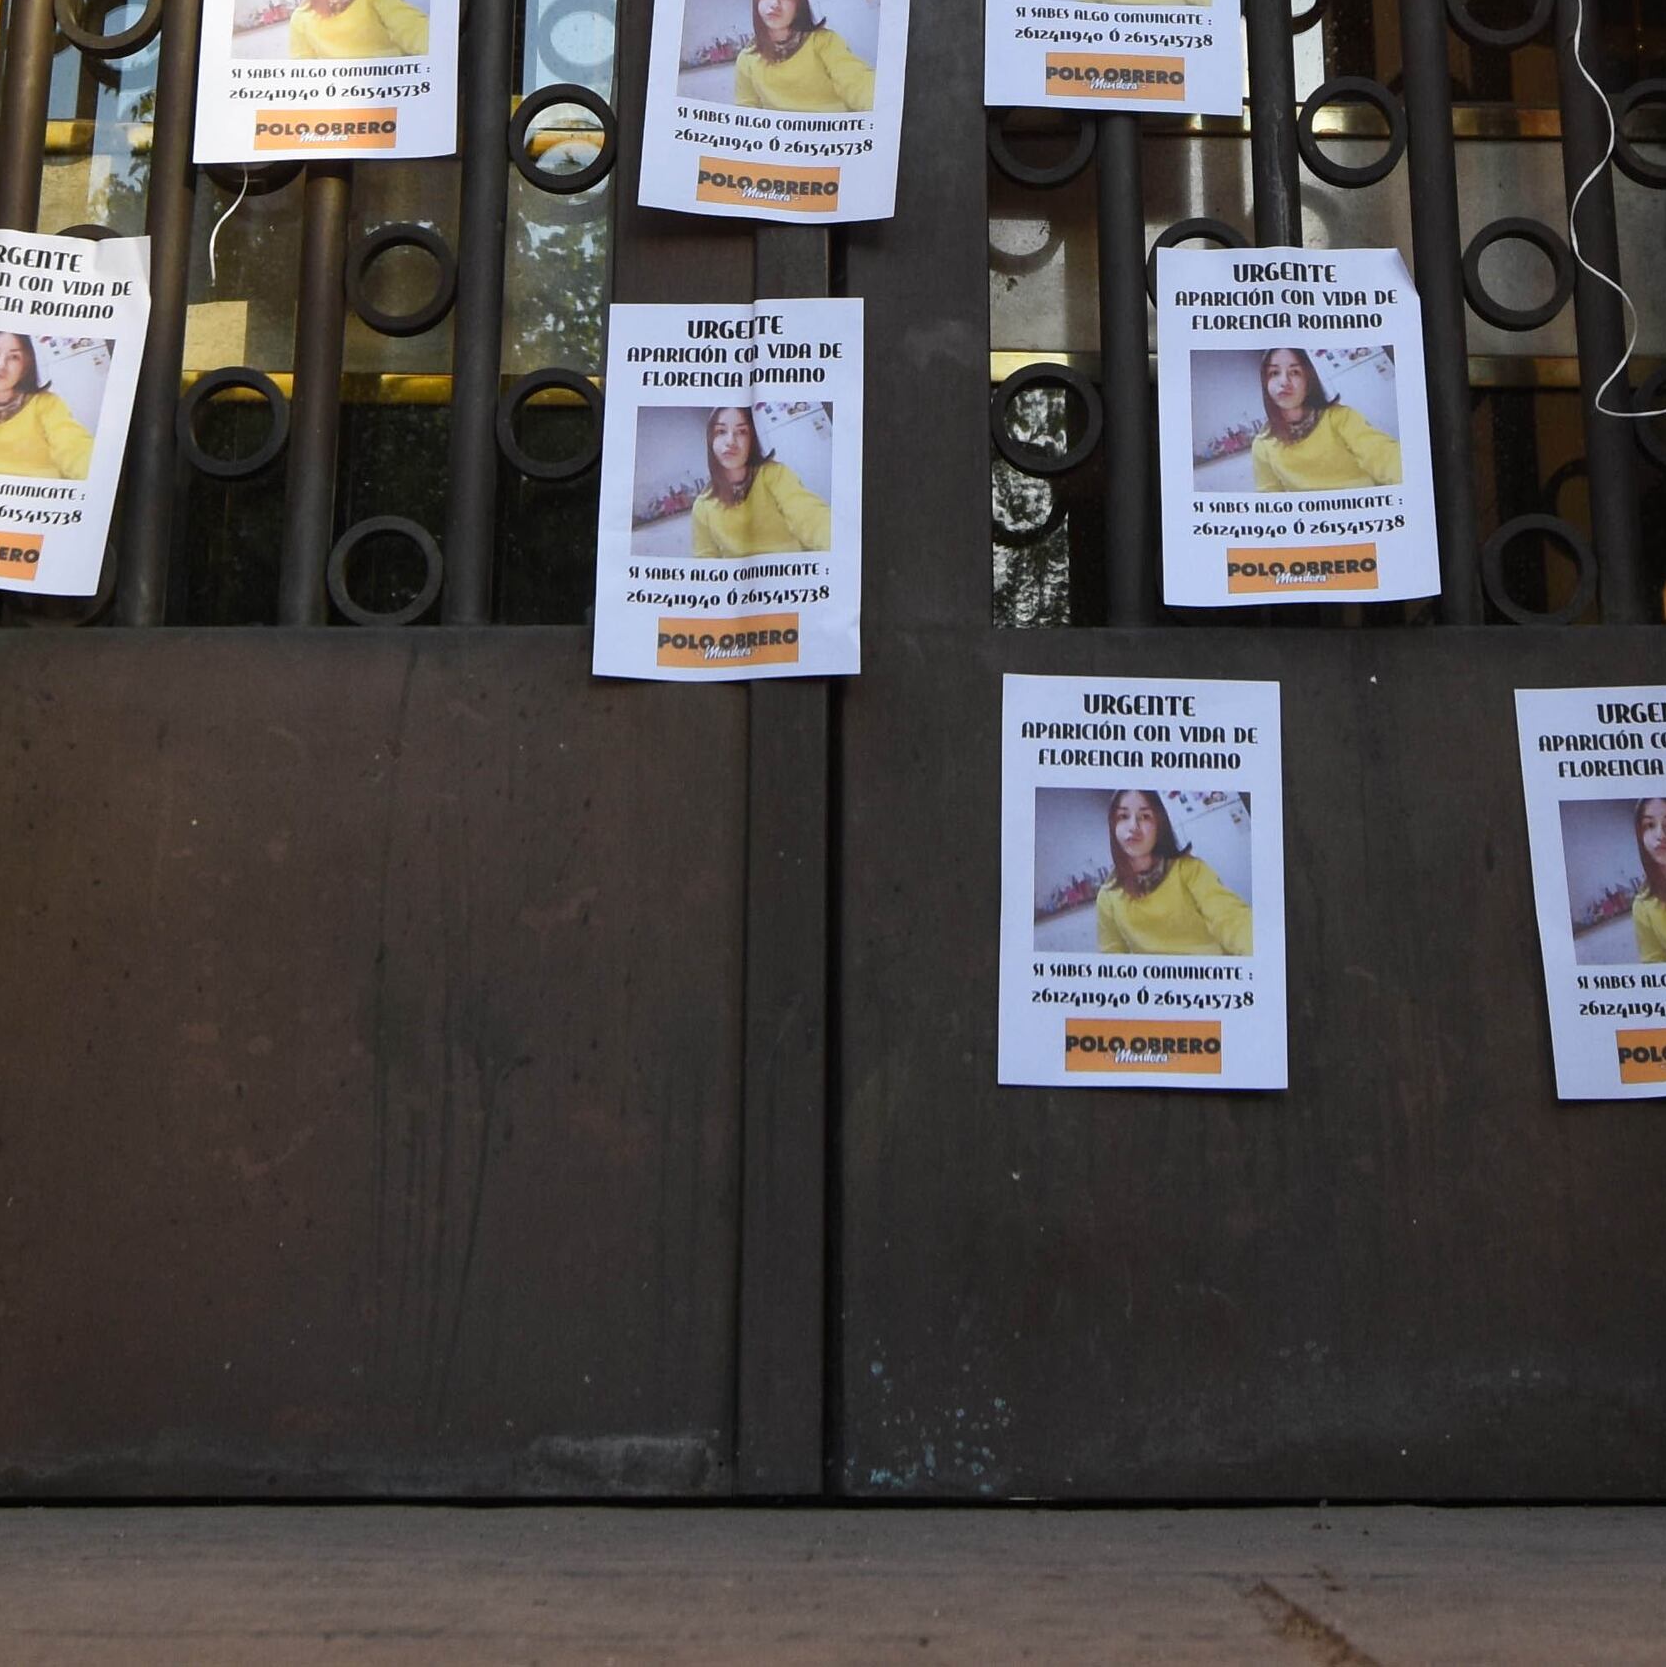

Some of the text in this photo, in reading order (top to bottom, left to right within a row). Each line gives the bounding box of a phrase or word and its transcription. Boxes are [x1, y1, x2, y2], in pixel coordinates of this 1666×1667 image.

[1233, 262, 1337, 282] URGENTE
[1176, 288, 1398, 306] APARICIÓN CON VIDA DE
[31, 300, 113, 319] ROMANO
[1192, 313, 1382, 330] FLORENCIA ROMANO
[642, 371, 742, 387] FLORENCIA
[1193, 502, 1203, 513] SI
[1210, 502, 1249, 513] SABES
[1255, 501, 1293, 513] ALGO
[1228, 558, 1377, 576] POLO OBRERO
[1083, 693, 1196, 717] URGENTE
[1021, 721, 1259, 744] APARICIÓN CON VIDA DE
[1539, 730, 1643, 752] APARICIÓN
[1038, 748, 1241, 769] FLORENCIA ROMANO
[1558, 759, 1664, 777] FLORENCIA
[1033, 963, 1044, 976] SI
[1050, 964, 1092, 978] SABES
[1098, 965, 1137, 979] ALGO
[1577, 976, 1588, 989] SI
[1594, 974, 1635, 989] SABES
[1066, 1036, 1221, 1054] POLO OBRERO
